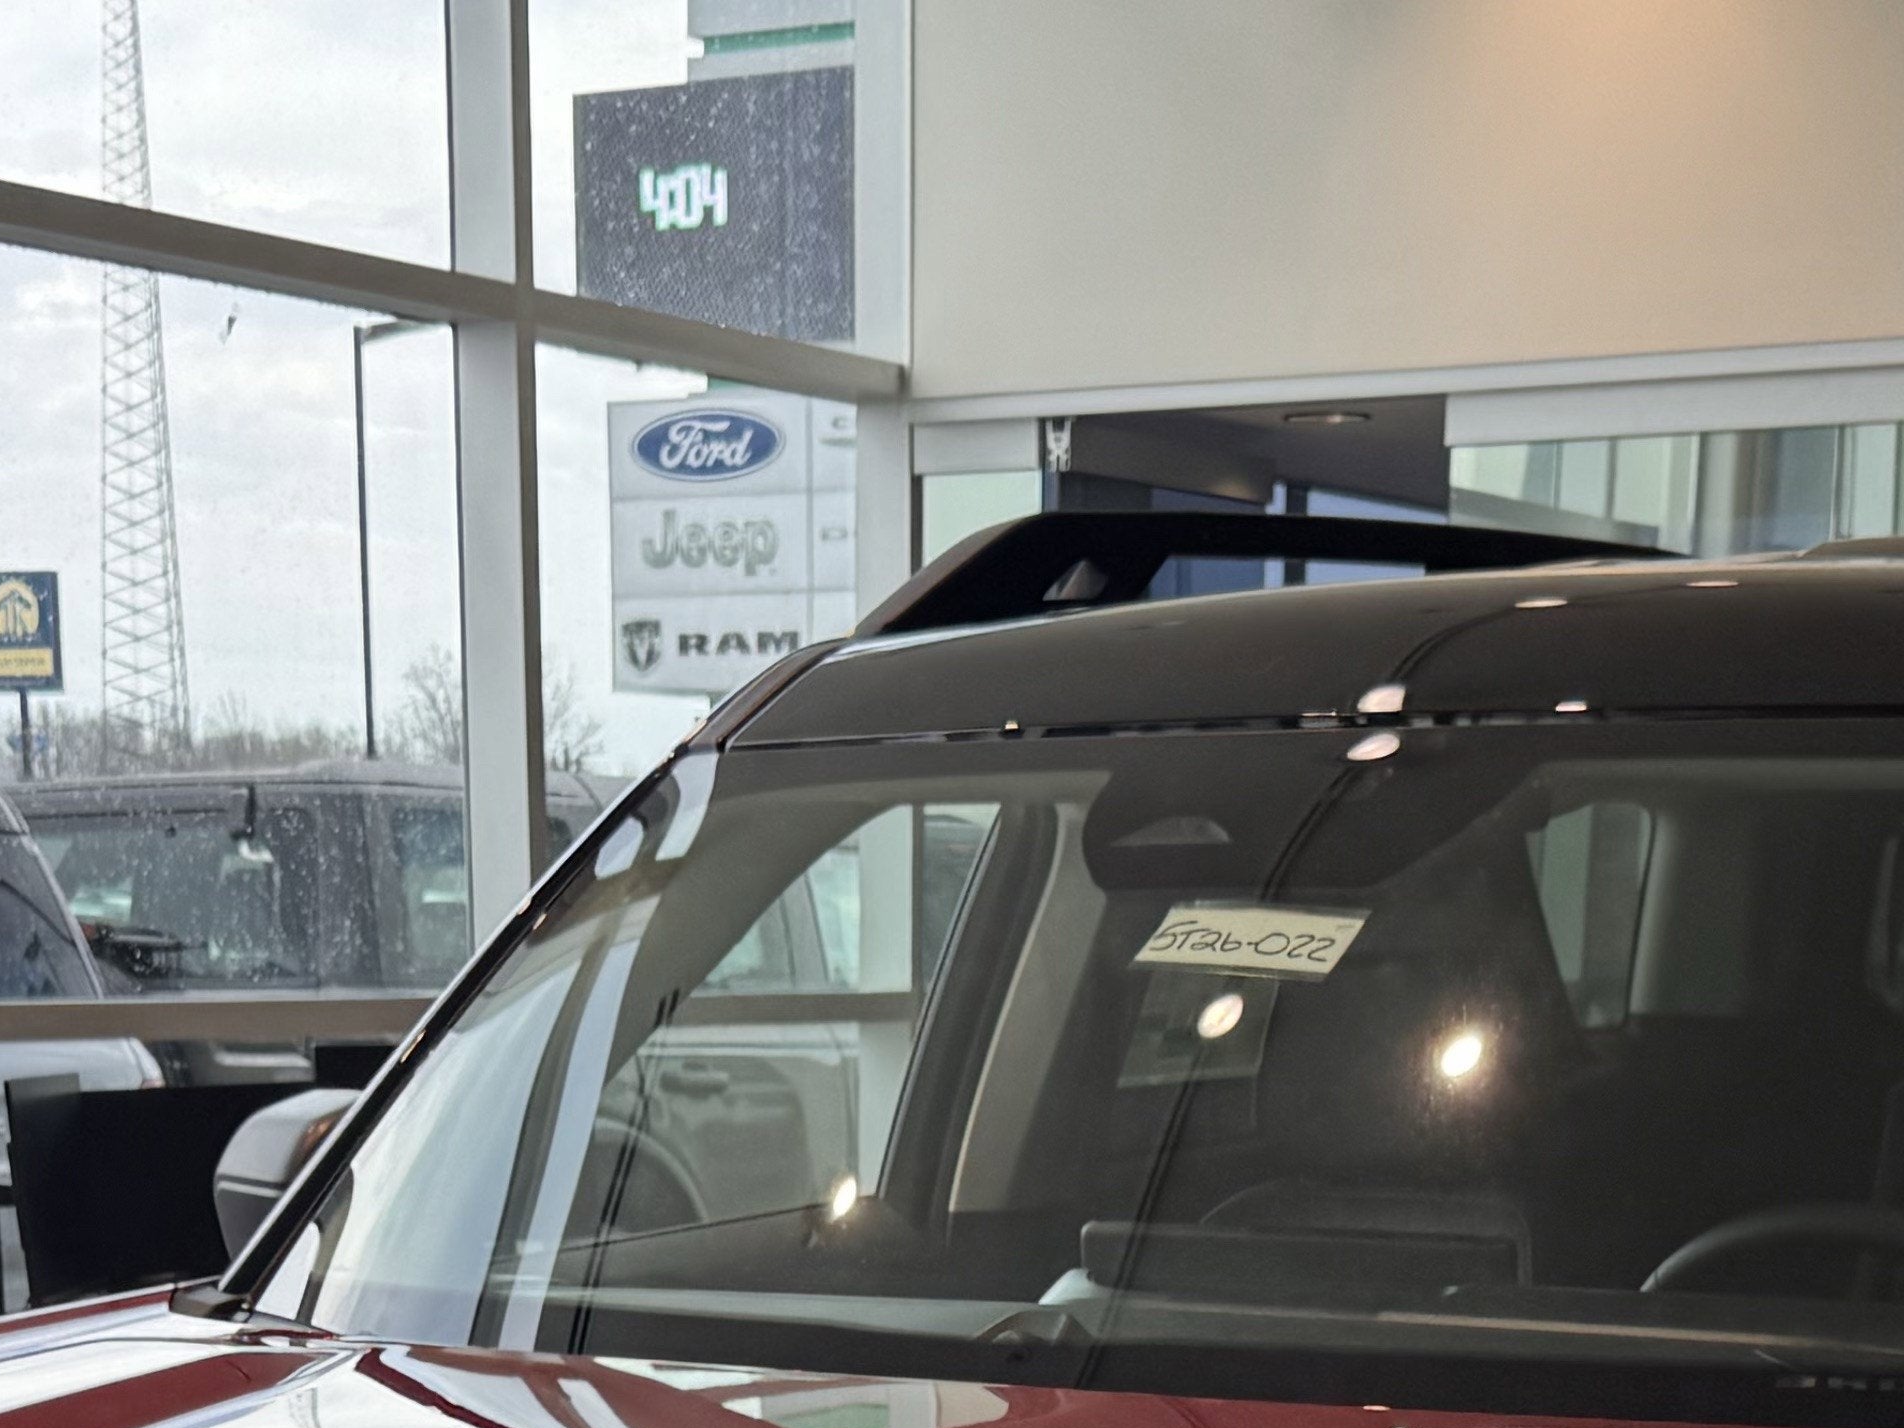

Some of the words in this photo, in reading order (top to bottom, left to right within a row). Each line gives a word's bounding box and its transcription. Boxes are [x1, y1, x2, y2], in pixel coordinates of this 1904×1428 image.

[659, 420, 755, 470] Ford
[641, 508, 779, 577] Jeep
[678, 630, 801, 657] RAM
